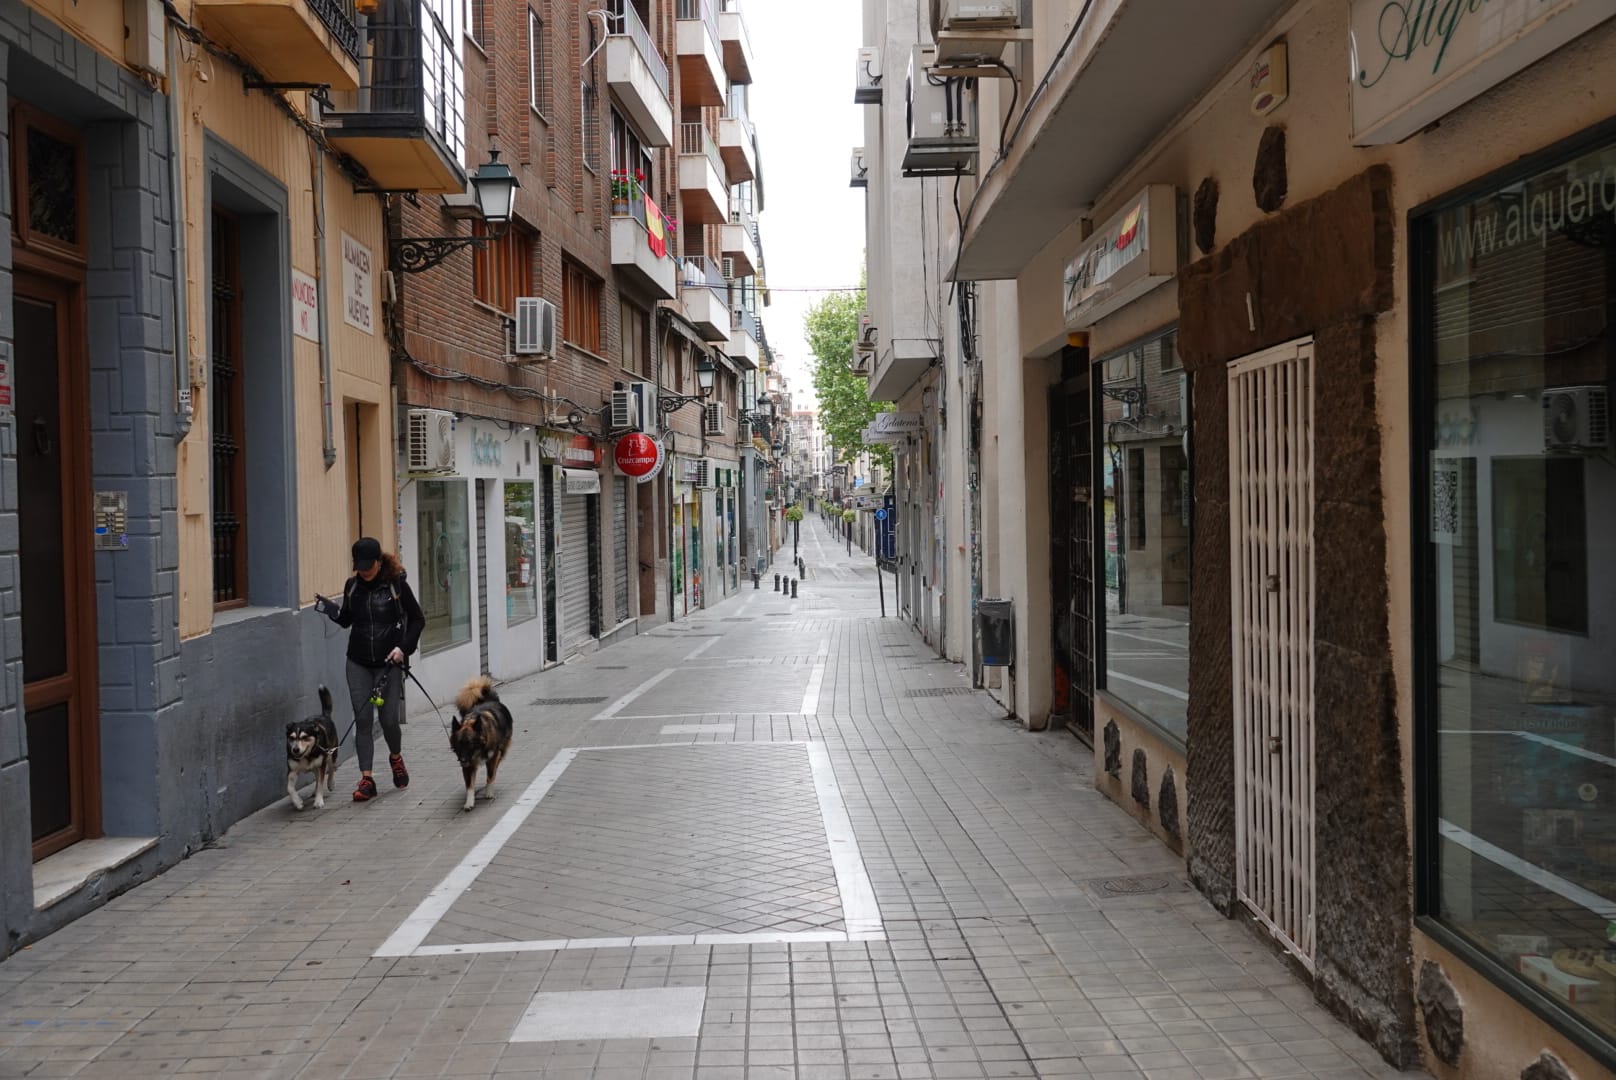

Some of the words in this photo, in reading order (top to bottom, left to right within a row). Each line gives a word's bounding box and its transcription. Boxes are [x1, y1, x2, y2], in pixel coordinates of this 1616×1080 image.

[355, 272, 362, 297] DE
[348, 296, 369, 328] HUEVOS
[617, 456, 655, 465] Cruzcampo
